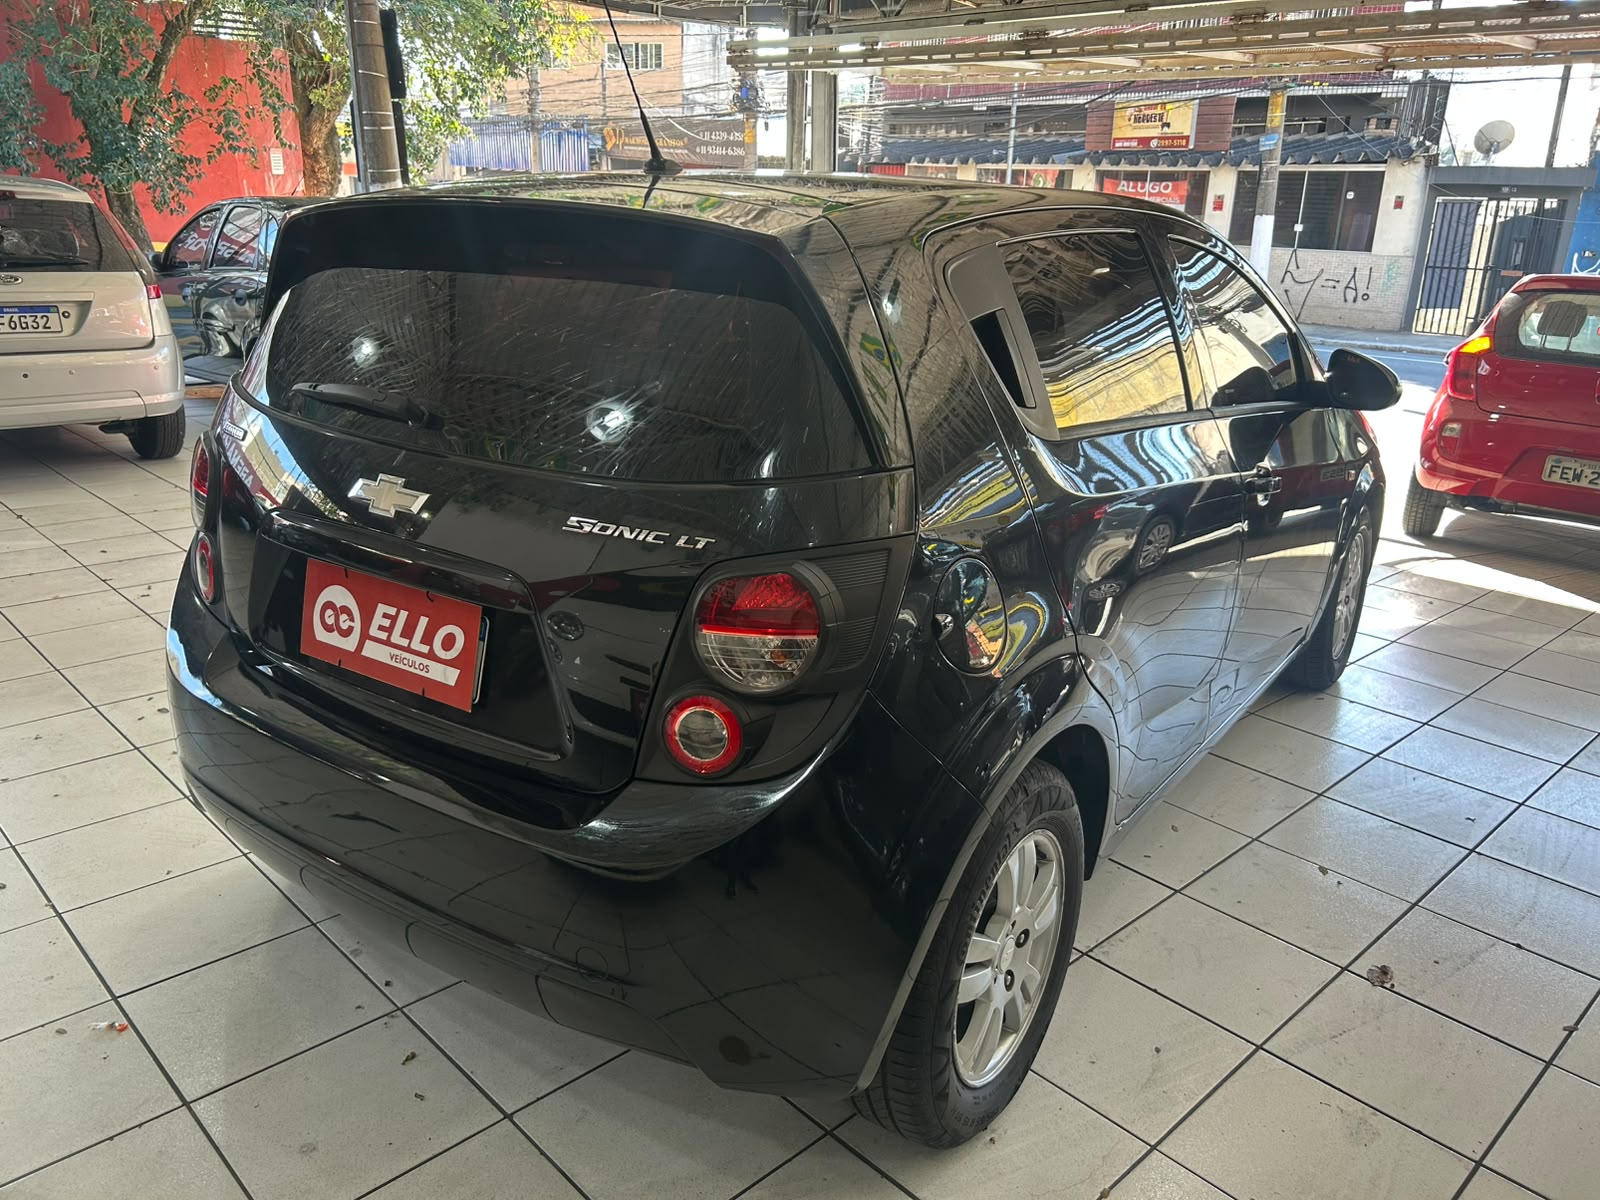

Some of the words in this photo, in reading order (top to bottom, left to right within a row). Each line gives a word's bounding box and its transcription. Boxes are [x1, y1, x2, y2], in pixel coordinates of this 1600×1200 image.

[1117, 181, 1173, 194] ALUGO
[562, 516, 670, 544] SONIC
[675, 535, 716, 549] LT
[368, 602, 465, 660] ELLO
[389, 652, 430, 674] VEÍCULOS
